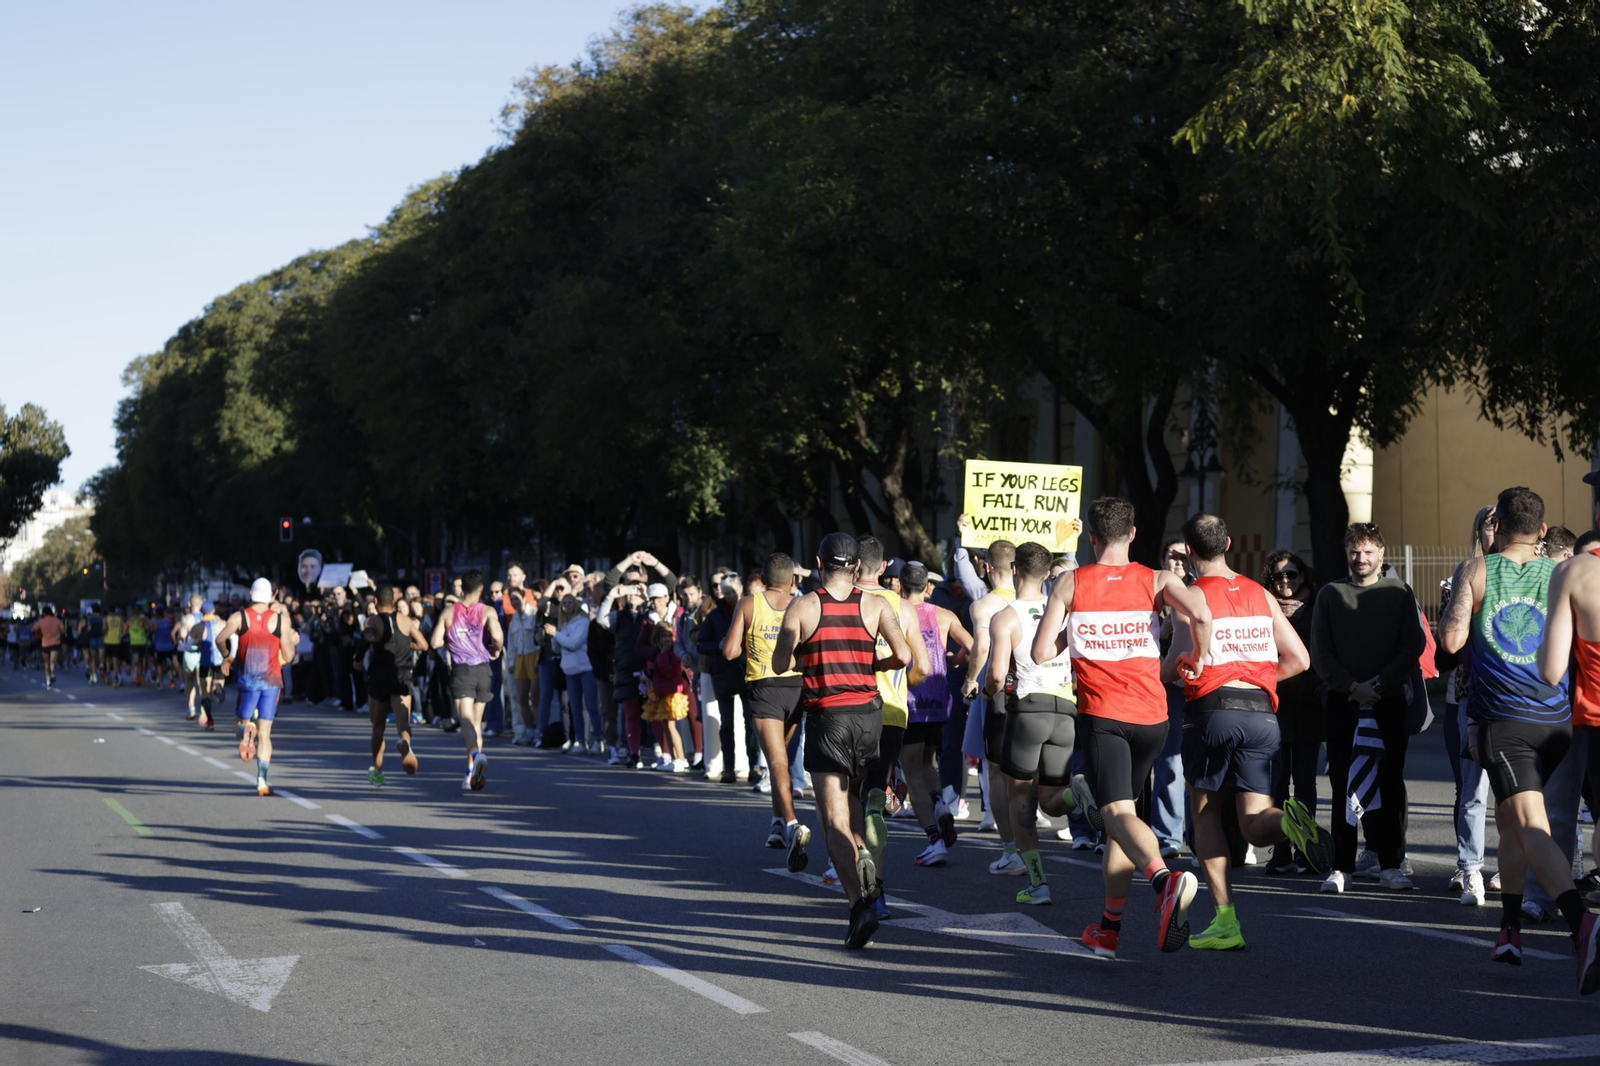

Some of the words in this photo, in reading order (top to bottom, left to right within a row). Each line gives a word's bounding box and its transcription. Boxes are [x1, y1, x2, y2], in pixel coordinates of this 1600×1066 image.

[972, 472, 996, 487] IF
[1000, 473, 1038, 489] YOUR
[1042, 476, 1079, 492] LEGS
[983, 493, 1029, 513] FAIL,
[1034, 495, 1069, 513] RUN
[971, 516, 1017, 531] WITH
[1021, 517, 1052, 534] YOUR
[1494, 599, 1509, 611] DEL
[1511, 597, 1542, 609] PARQUE
[1077, 623, 1097, 635] CS
[1101, 622, 1151, 635] CLICHY
[1215, 628, 1232, 641] CS
[1235, 627, 1271, 640] CLICHY
[1084, 637, 1149, 650] ATHLETISME
[1222, 642, 1269, 653] ATHLETISME
[1502, 653, 1535, 663] SEVILL
